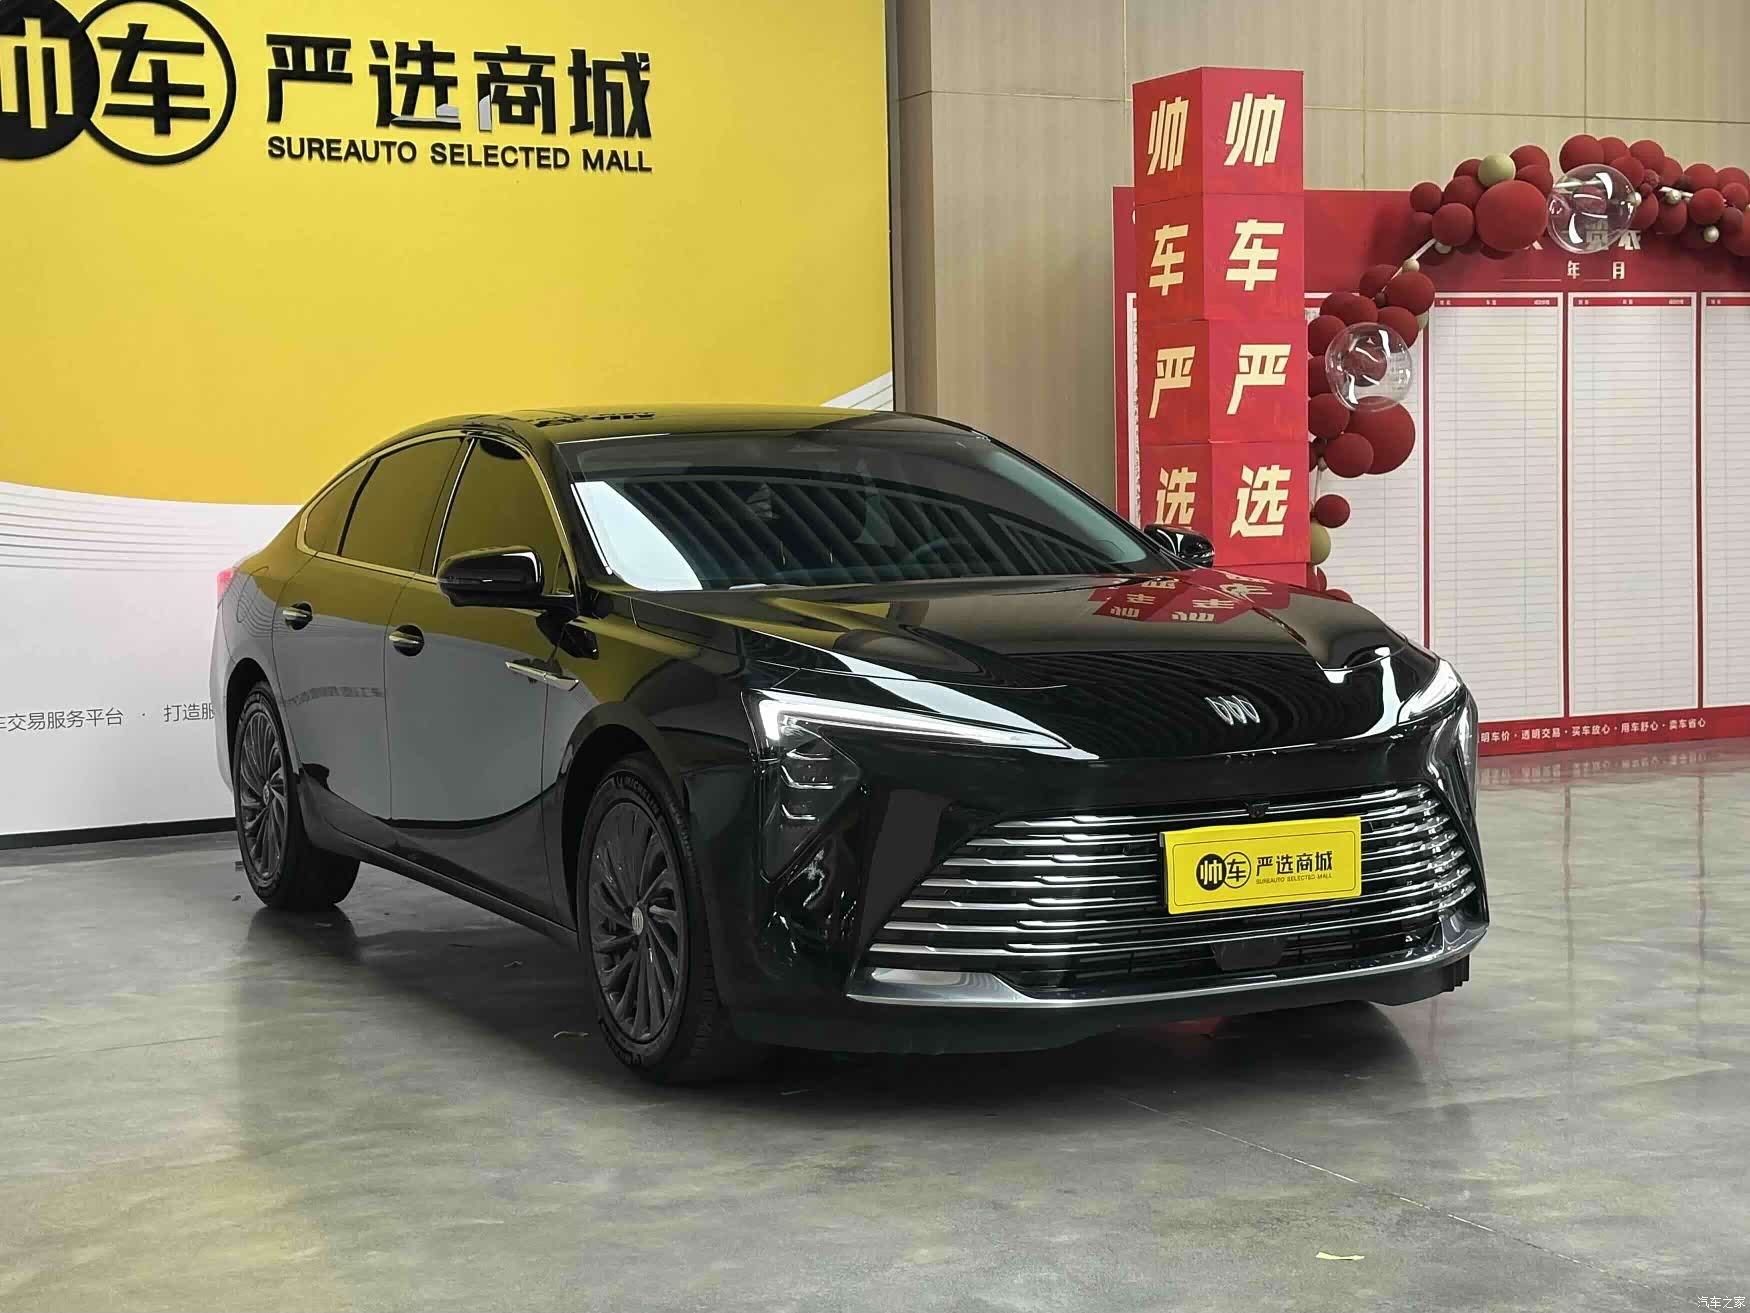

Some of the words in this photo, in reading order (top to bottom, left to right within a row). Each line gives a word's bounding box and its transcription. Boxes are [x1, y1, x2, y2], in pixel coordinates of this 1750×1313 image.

[266, 34, 652, 138] 严选商城
[267, 136, 417, 164] SUREAUTO
[430, 142, 570, 169] SELECTED
[582, 149, 652, 172] MALL
[1567, 260, 1580, 279] 年
[1612, 261, 1625, 279] 月
[1223, 92, 1292, 538] 帅车严选
[1255, 850, 1333, 877] 严选商城
